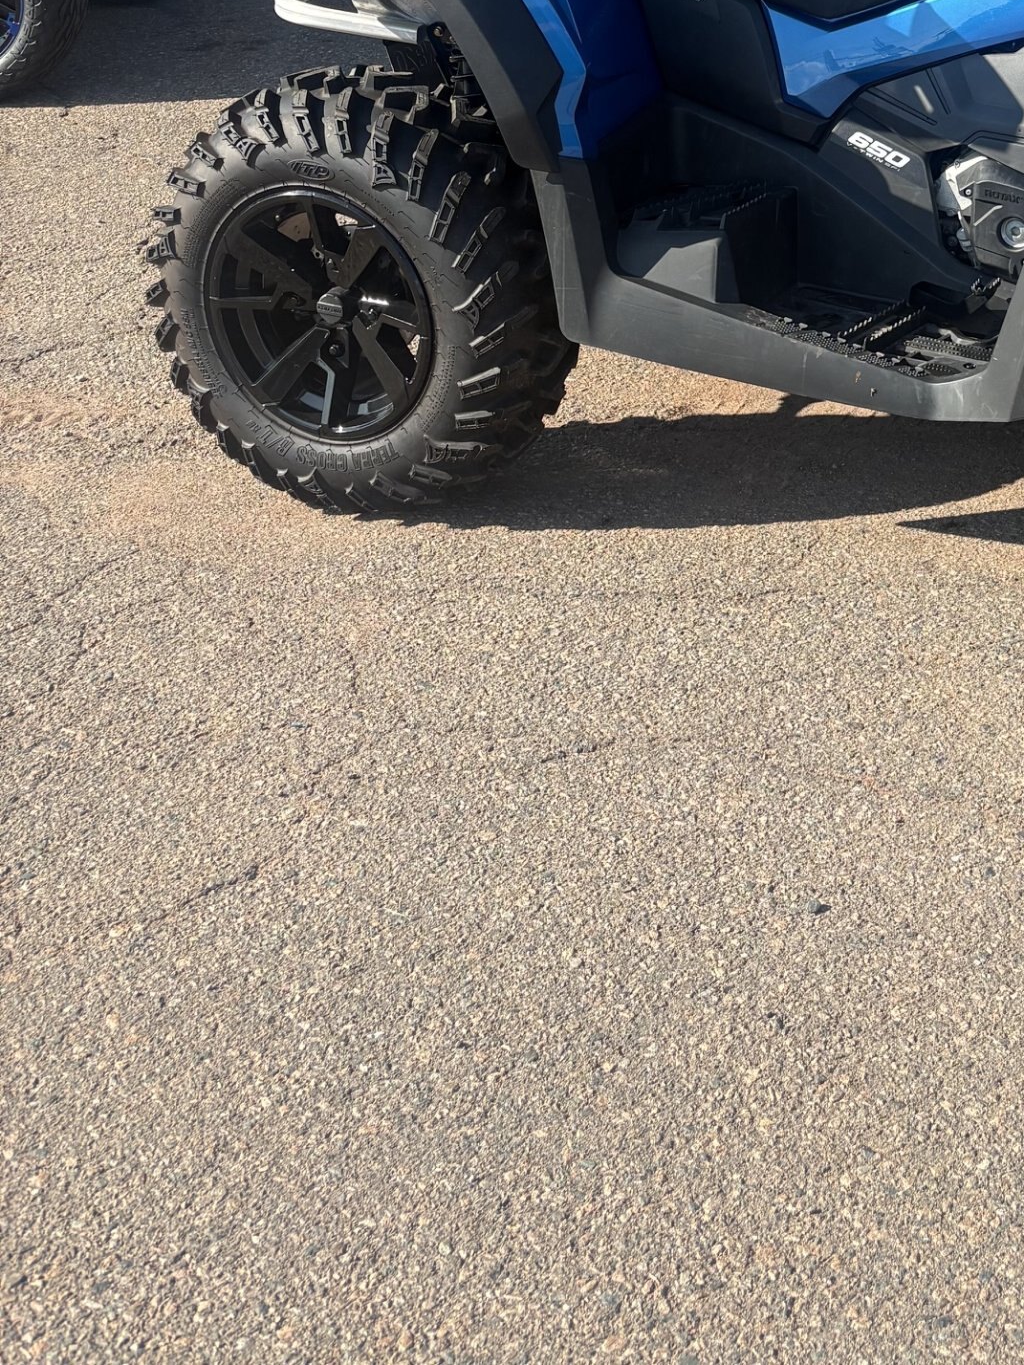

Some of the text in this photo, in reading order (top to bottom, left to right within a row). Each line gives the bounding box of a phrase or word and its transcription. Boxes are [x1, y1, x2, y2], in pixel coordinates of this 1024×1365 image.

[846, 141, 884, 163] V-TWIN
[847, 131, 911, 168] 650
[290, 162, 330, 178] ITP
[296, 445, 348, 472] CROSS
[352, 439, 401, 472] TERRA
